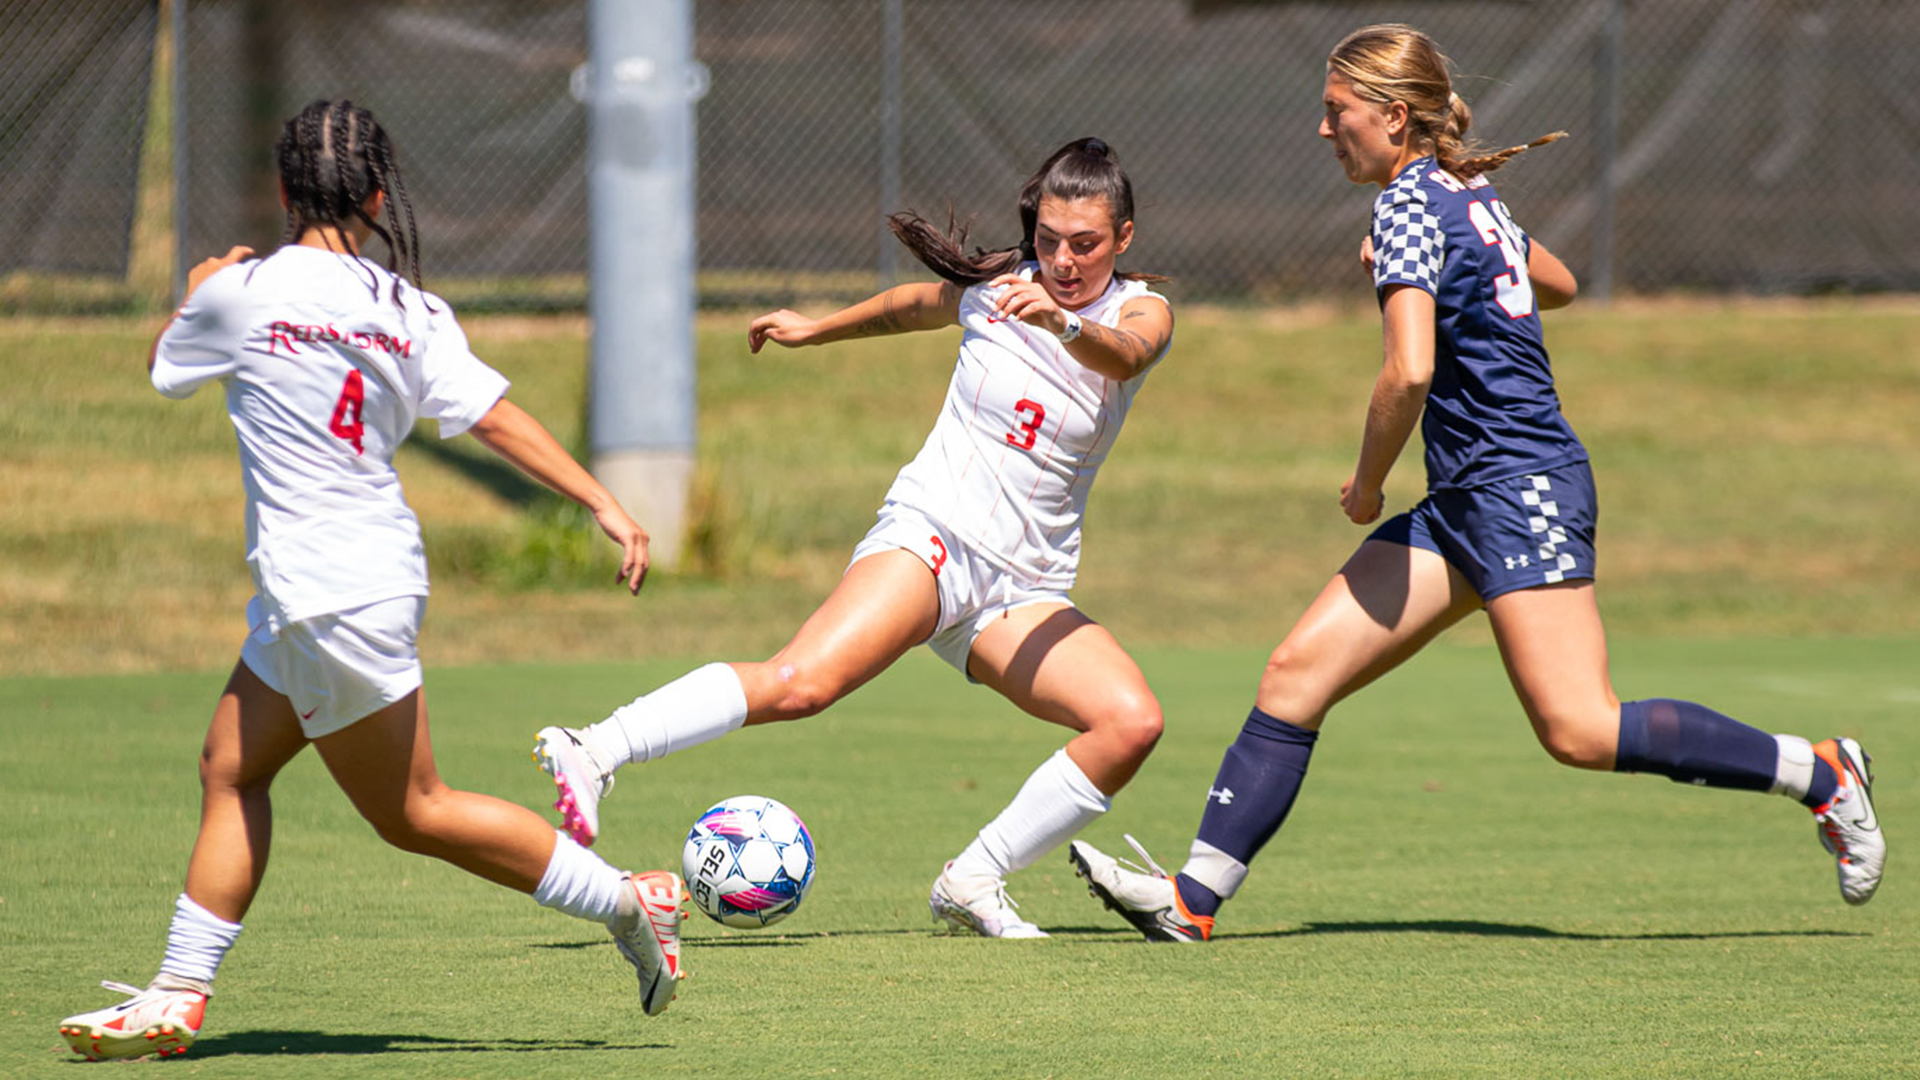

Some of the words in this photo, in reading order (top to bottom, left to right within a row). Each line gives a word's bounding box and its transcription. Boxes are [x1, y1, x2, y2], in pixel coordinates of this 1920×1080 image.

[1468, 199, 1533, 319] 3
[328, 368, 365, 457] 4
[1006, 398, 1046, 451] 3
[930, 535, 947, 577] 3
[695, 845, 726, 912] SELECT
